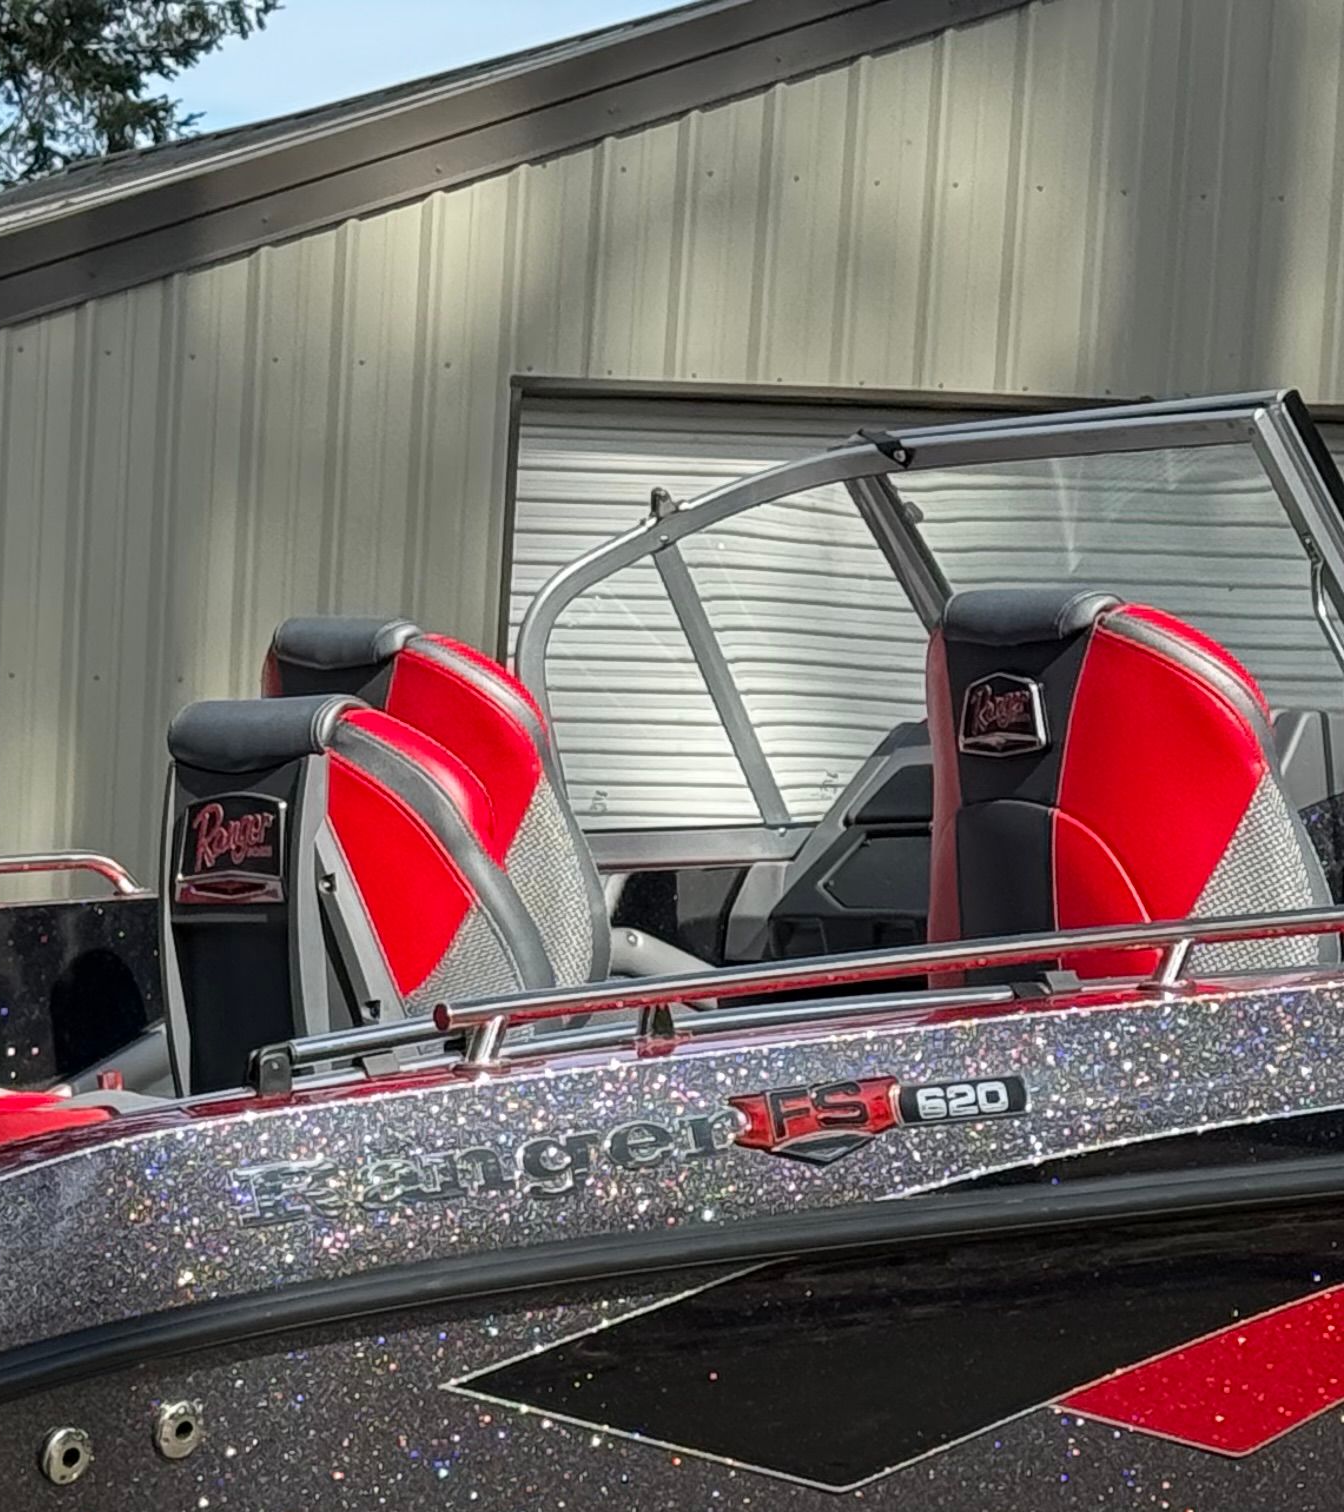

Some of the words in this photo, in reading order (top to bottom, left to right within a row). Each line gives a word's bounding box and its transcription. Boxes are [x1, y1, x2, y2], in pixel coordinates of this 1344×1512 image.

[192, 803, 275, 873] Ranger
[231, 1105, 748, 1228] Ranger
[762, 1079, 870, 1143] FS
[916, 1080, 1010, 1121] 620
